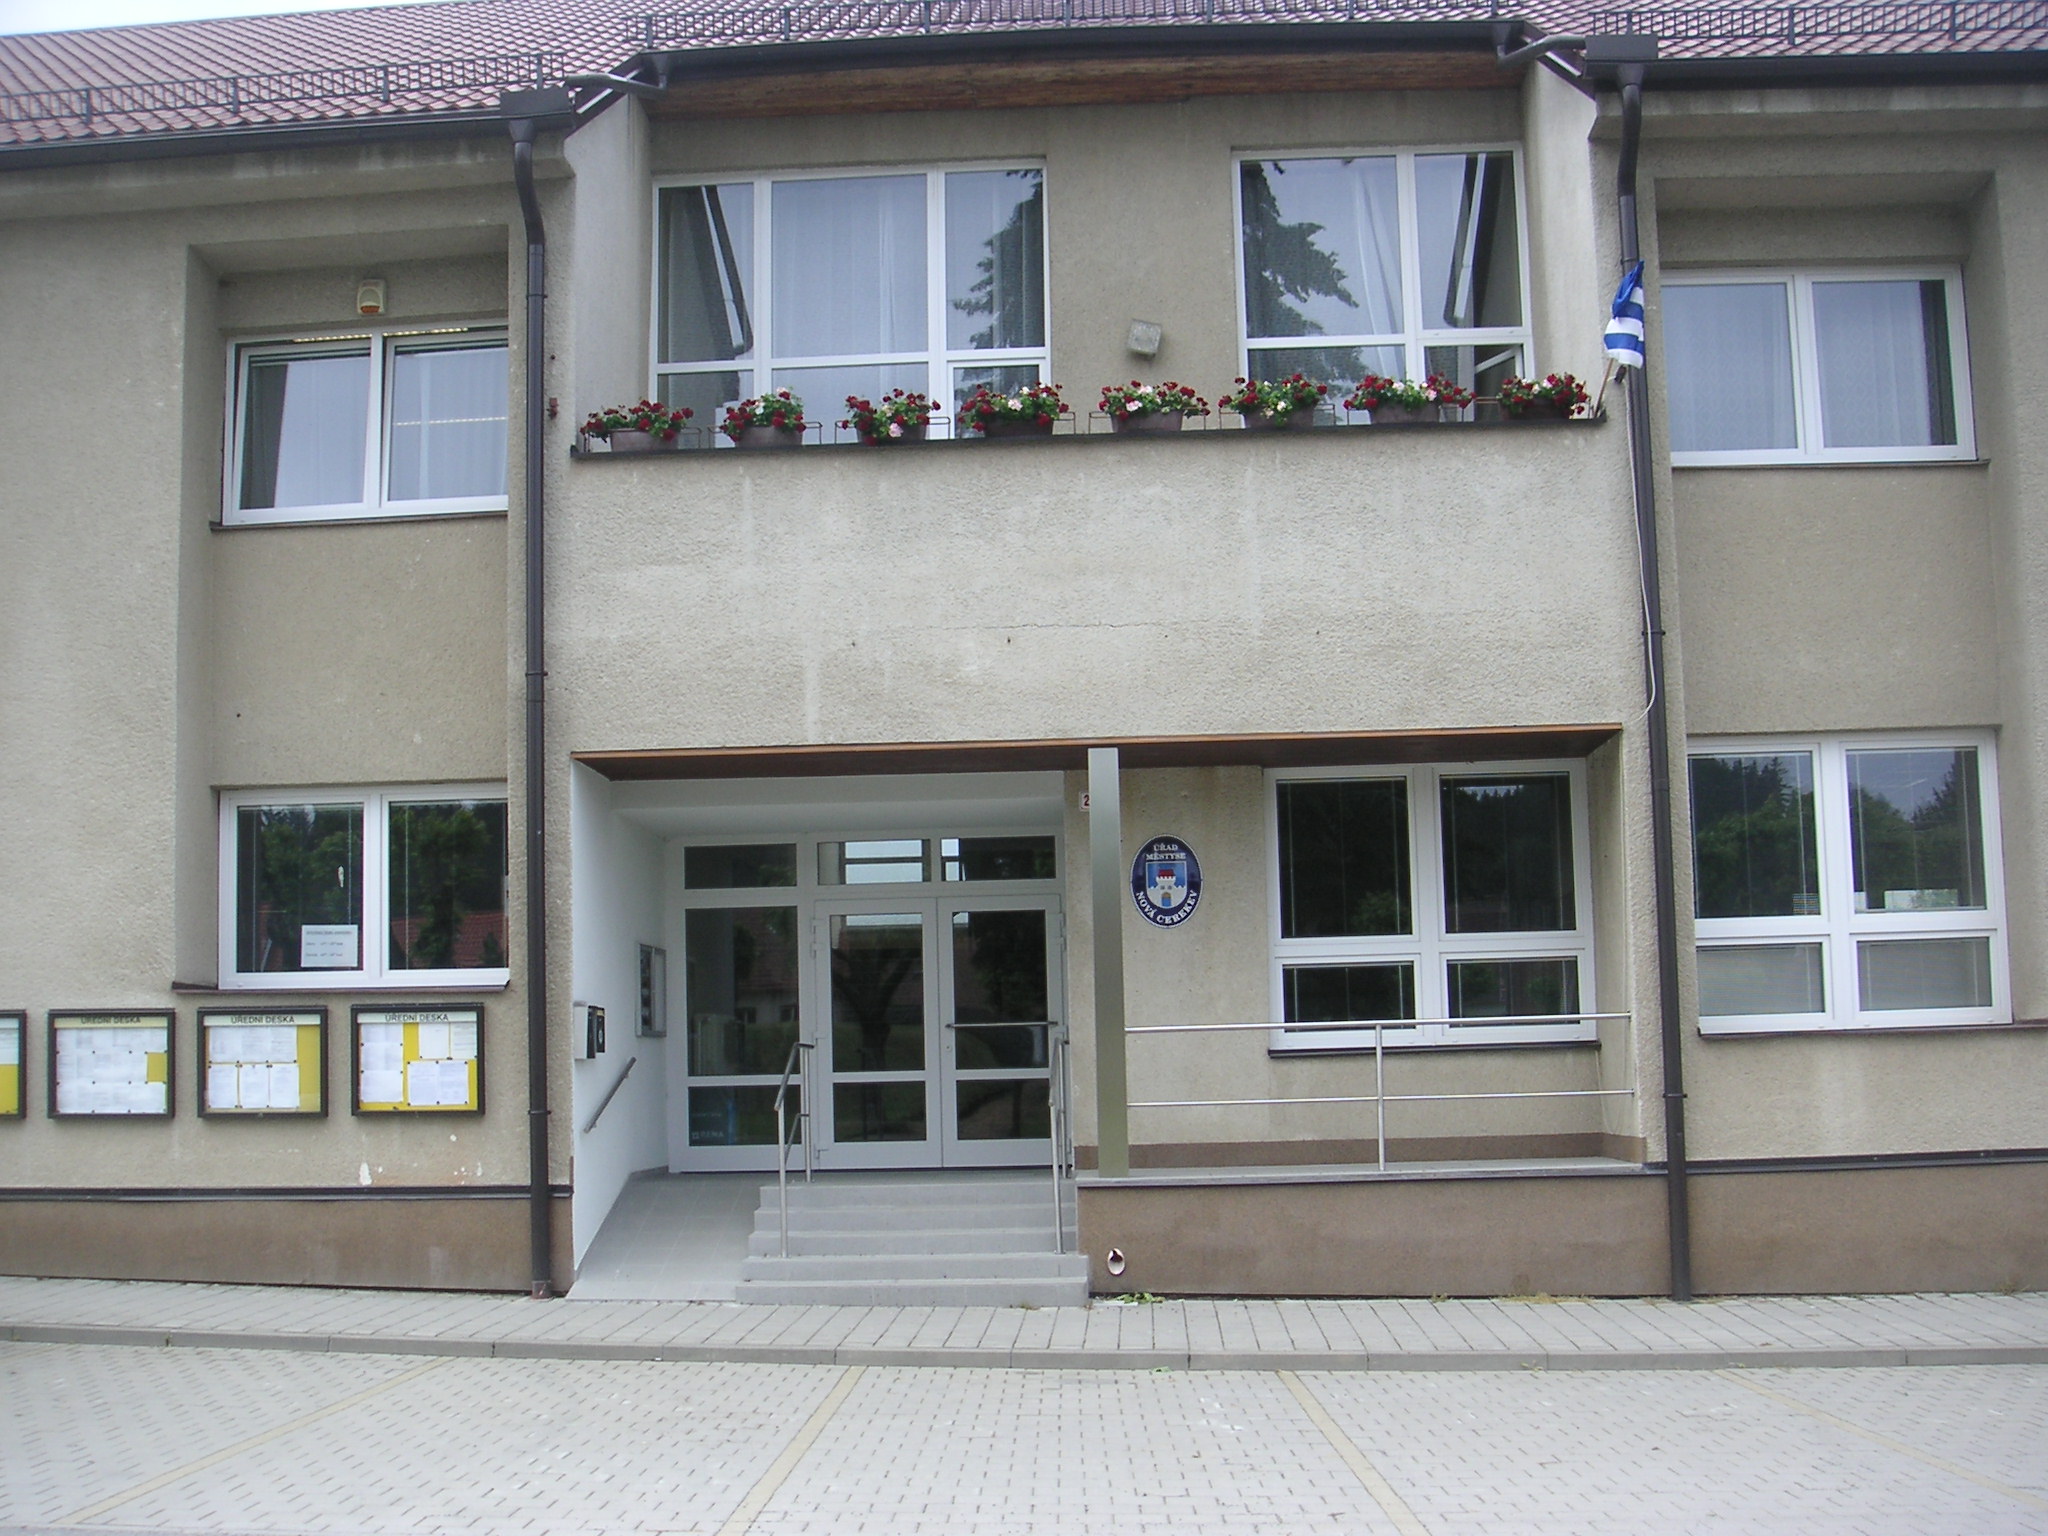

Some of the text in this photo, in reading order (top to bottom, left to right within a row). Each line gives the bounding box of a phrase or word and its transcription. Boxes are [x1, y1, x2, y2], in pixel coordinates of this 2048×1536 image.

[1153, 843, 1178, 851] ÚŘAD
[1136, 889, 1198, 924] NOVÁ CEREKEV
[113, 1016, 142, 1024] DESKA
[265, 1014, 295, 1024] DESKA
[419, 1013, 449, 1022] DESKA
